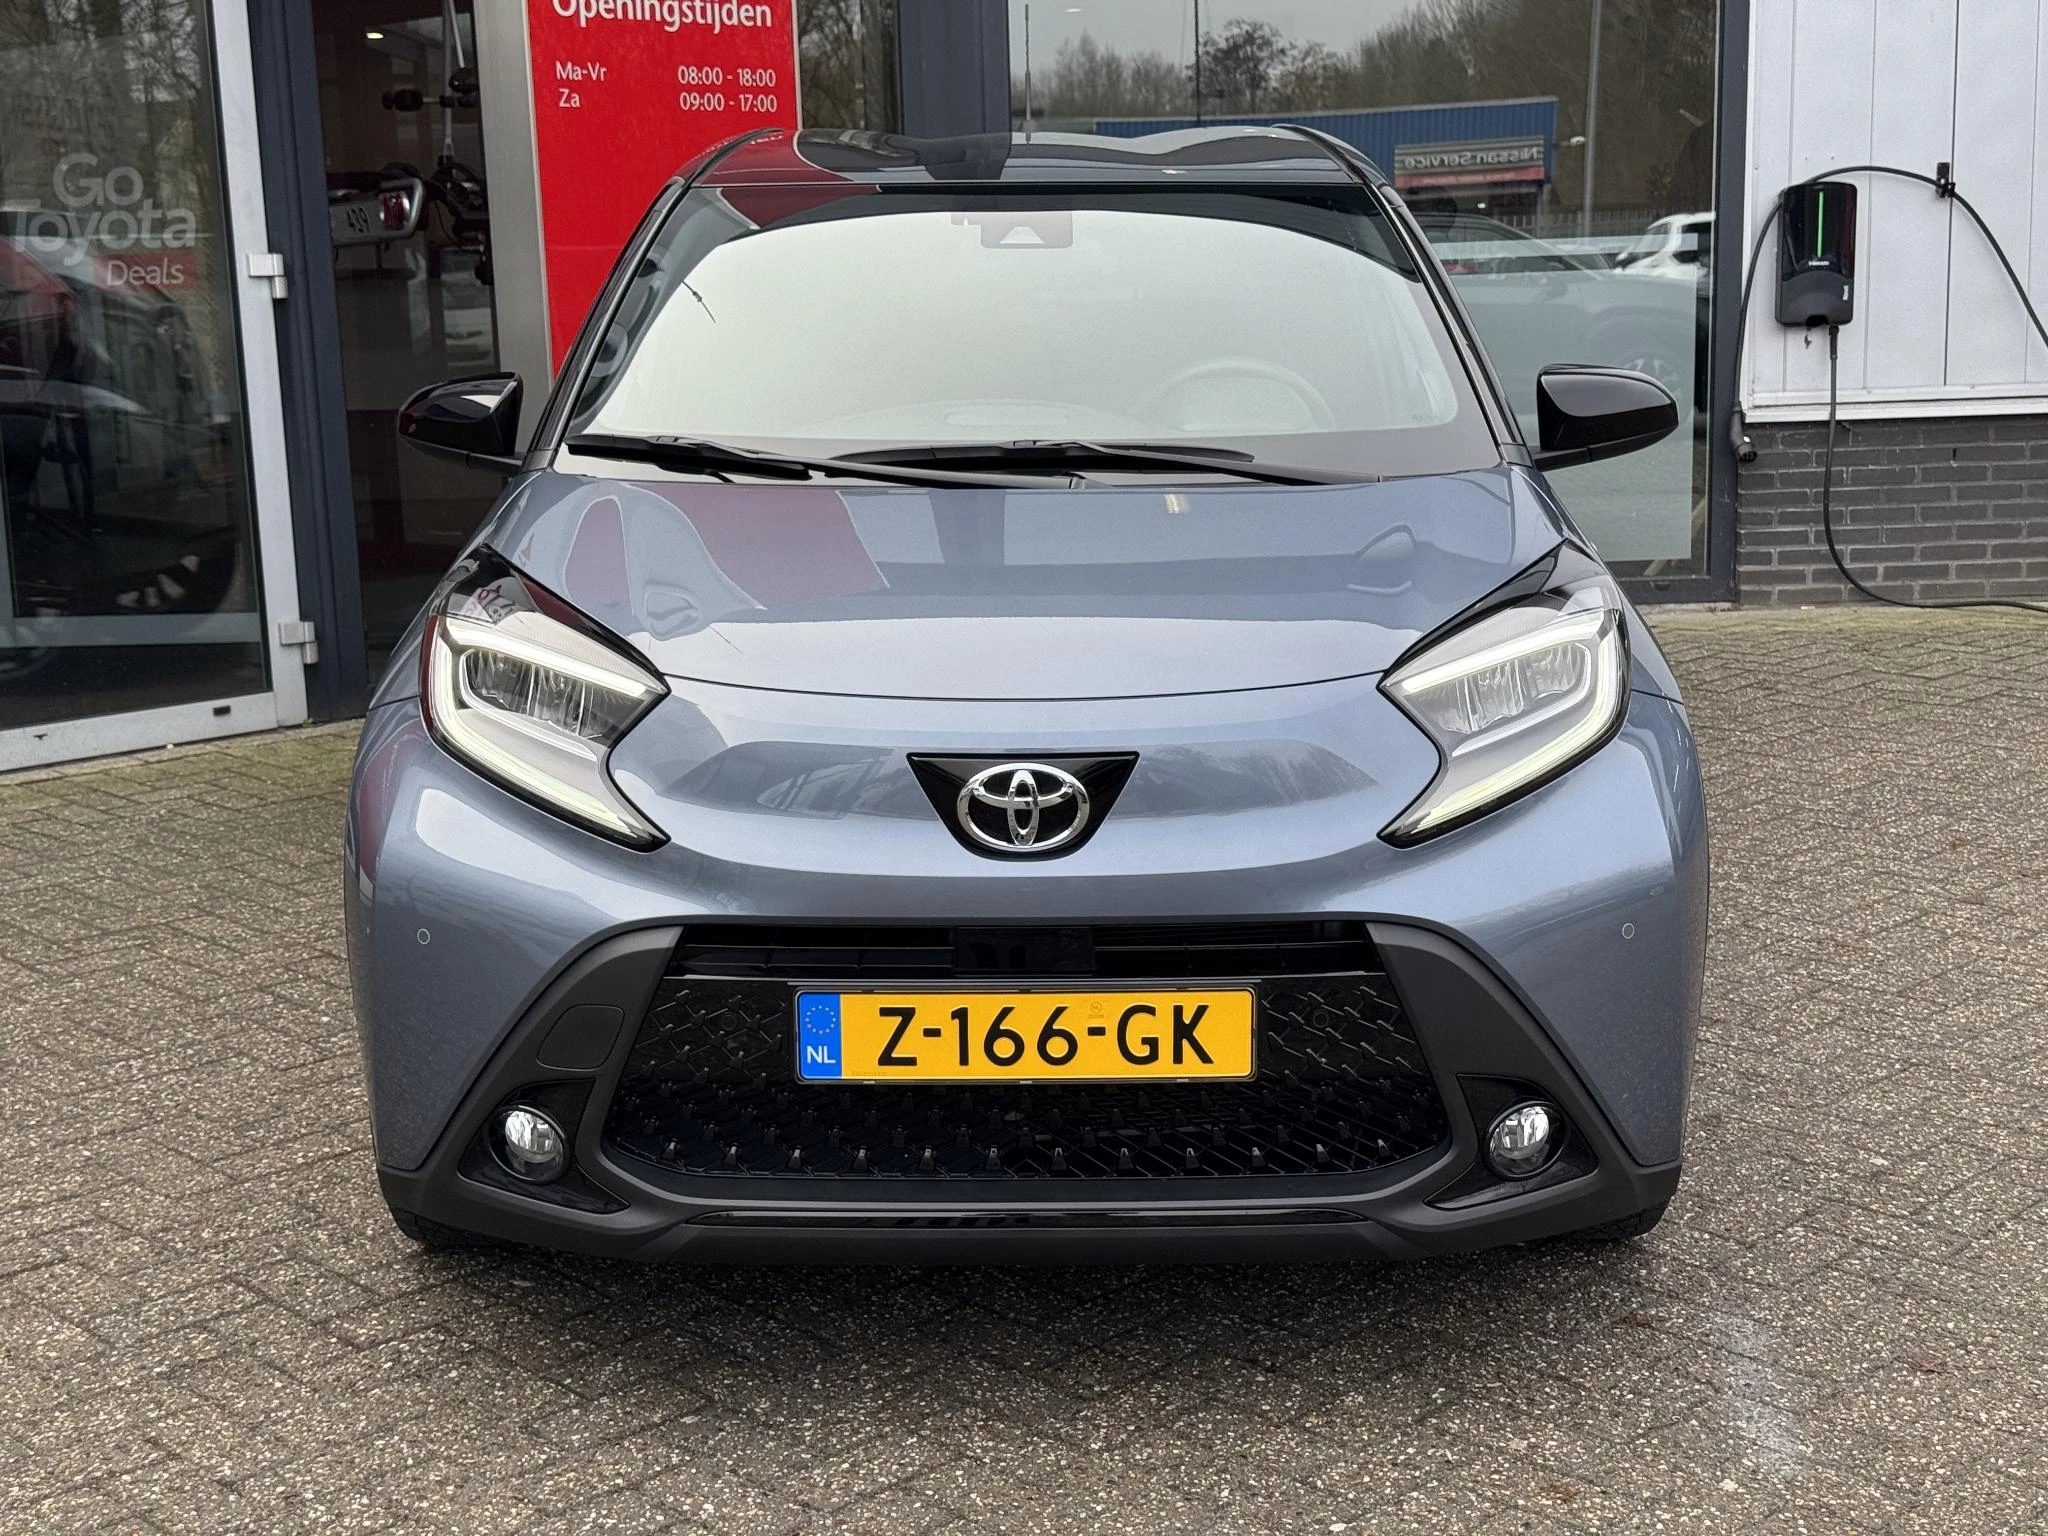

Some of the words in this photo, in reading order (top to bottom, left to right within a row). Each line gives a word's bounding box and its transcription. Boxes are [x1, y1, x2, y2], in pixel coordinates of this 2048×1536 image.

[553, 0, 772, 34] Openingstijden
[555, 60, 607, 82] Ma-Vr
[678, 65, 723, 86] 08:00
[737, 68, 776, 88] 18:00
[559, 88, 580, 108] Za
[680, 92, 724, 111] 09:00
[739, 94, 777, 112] 17:00
[53, 152, 144, 208] Go
[4, 198, 197, 267] Toyota
[107, 257, 185, 286] Deals
[877, 1004, 1215, 1067] Z-166-GK
[806, 1045, 836, 1065] NL
